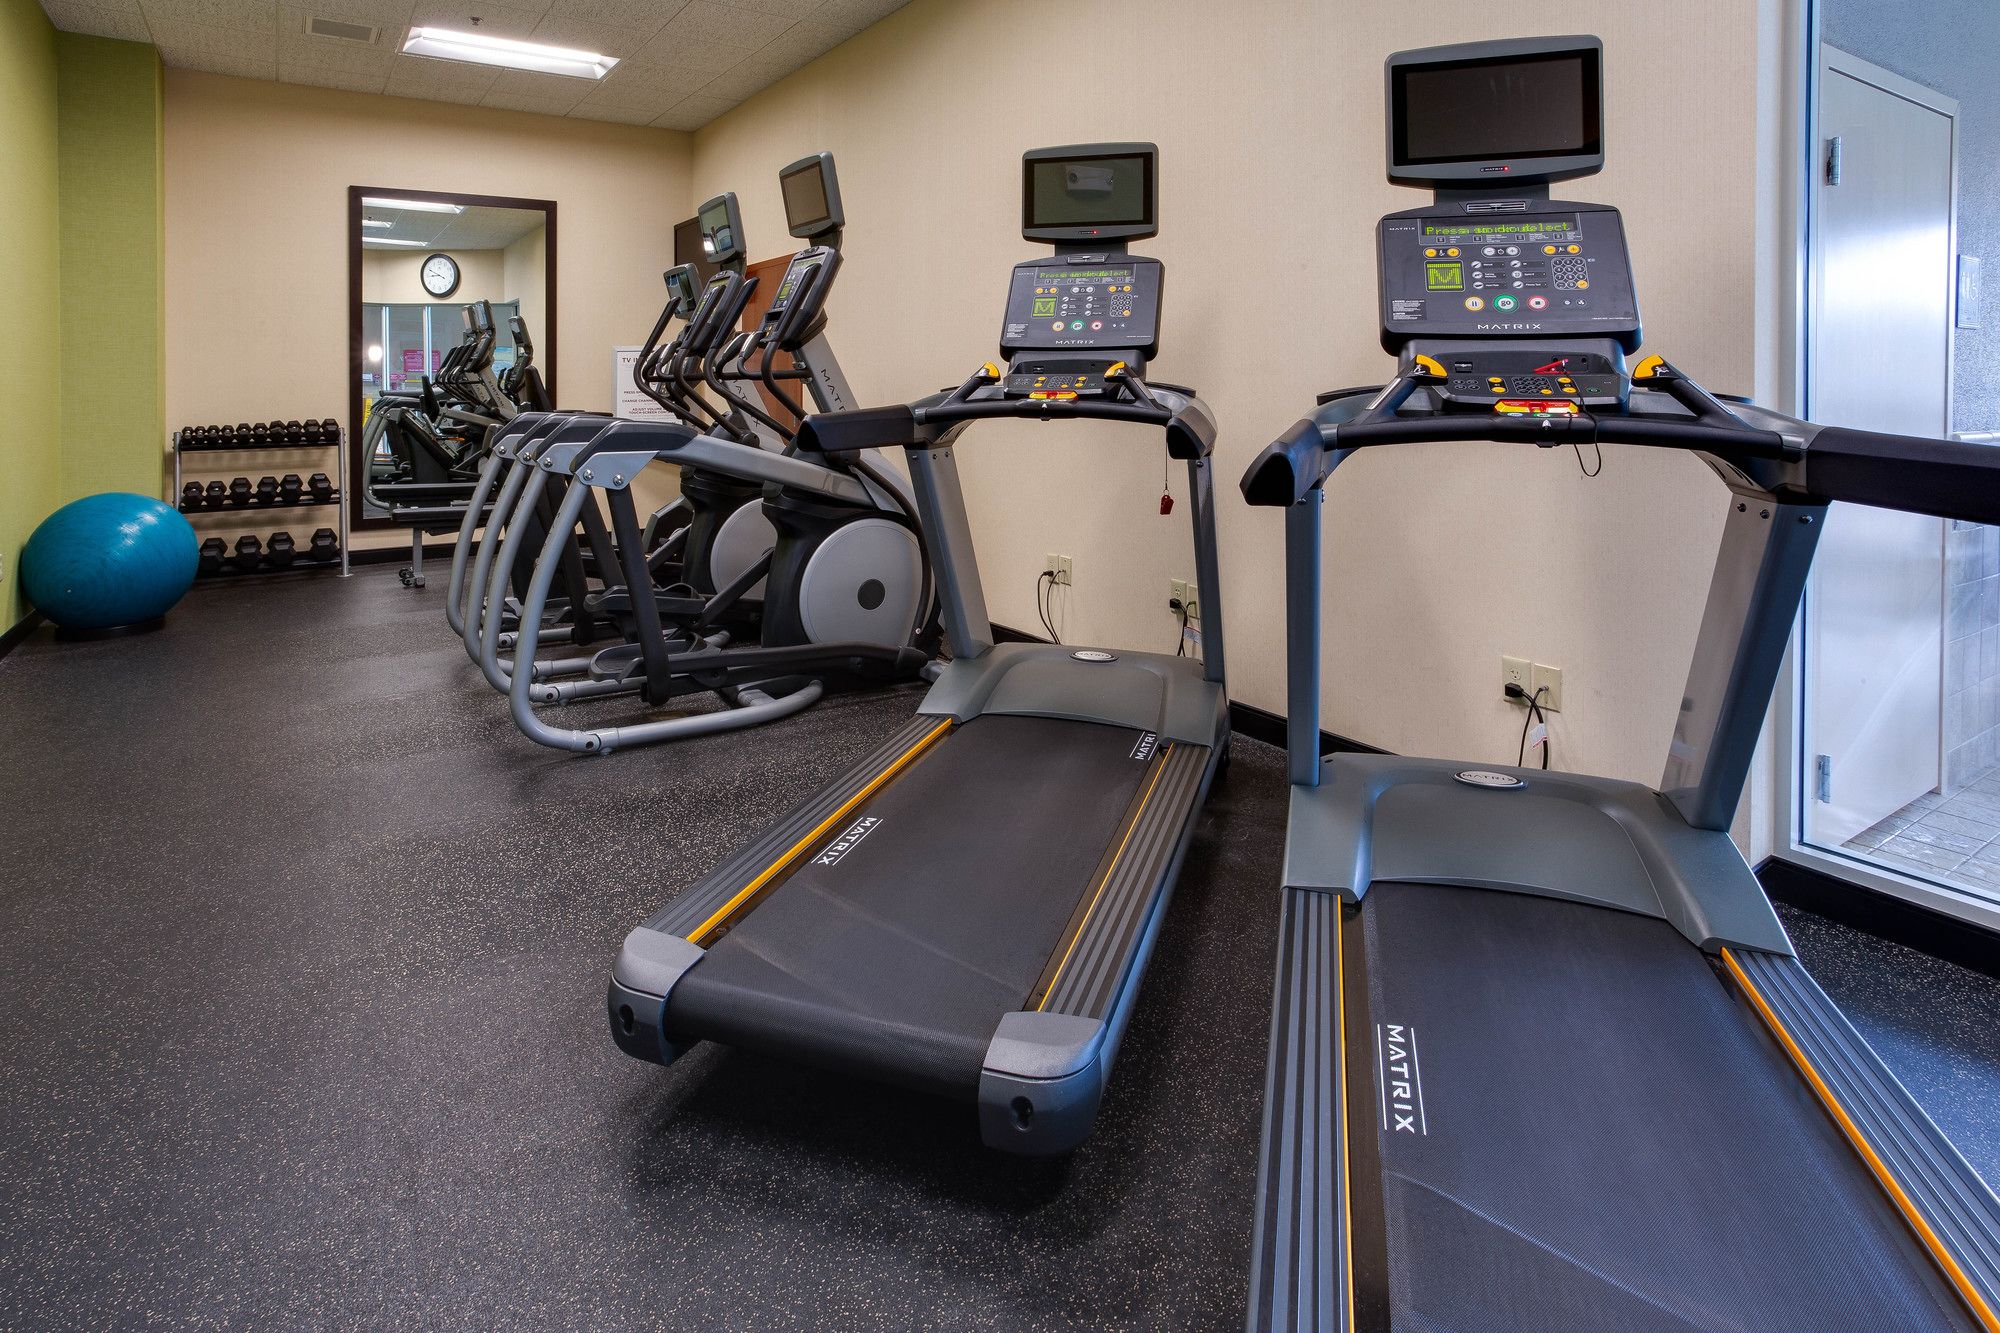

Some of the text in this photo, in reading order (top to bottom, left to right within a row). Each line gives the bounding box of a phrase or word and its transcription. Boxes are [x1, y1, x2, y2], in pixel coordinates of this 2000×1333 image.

[1134, 733, 1157, 760] MATRI
[1461, 772, 1514, 782] MATRIX
[817, 817, 878, 865] MATRIX
[1386, 1024, 1415, 1134] MATRIX
